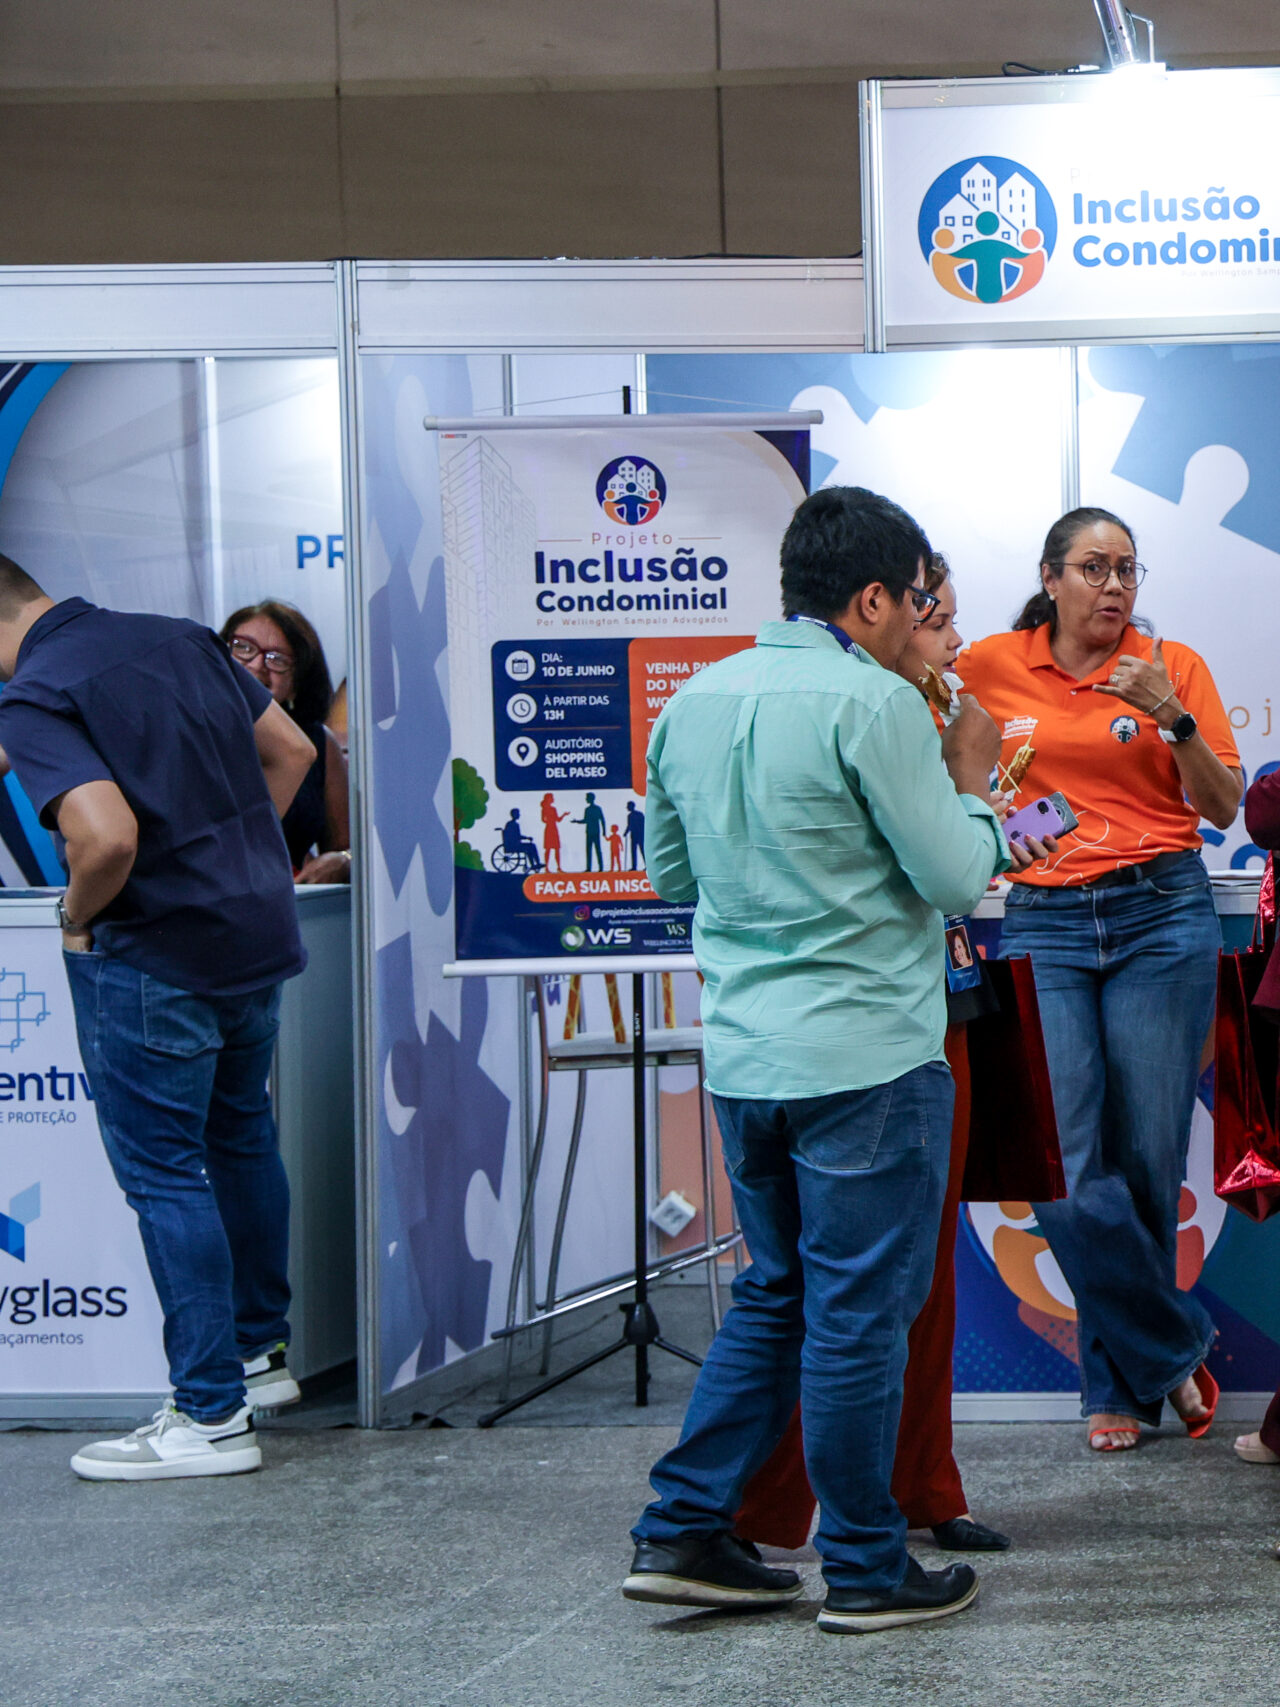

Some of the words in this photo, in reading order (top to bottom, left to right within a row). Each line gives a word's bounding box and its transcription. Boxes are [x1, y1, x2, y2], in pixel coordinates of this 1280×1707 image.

[1073, 186, 1261, 225] Inclusão
[591, 532, 673, 548] Projeto
[535, 547, 729, 584] Inclusão
[536, 587, 728, 613] Condominial
[536, 618, 555, 626] Por
[562, 617, 620, 628] Wellington
[624, 616, 668, 627] Sampaio
[673, 615, 729, 625] Advogados
[541, 652, 563, 664] DIA:
[542, 666, 556, 677] 10
[557, 665, 574, 677] DE
[575, 664, 615, 676] JUNHO
[645, 662, 690, 675] VENHA
[646, 679, 668, 692] DO
[553, 696, 589, 706] PARTIR
[590, 695, 610, 706] DAS
[543, 710, 565, 721] 13H
[544, 737, 603, 750] AUDITÓRIO
[545, 752, 605, 764] SHOPPING
[545, 767, 569, 779] DEL
[569, 766, 607, 778] PASEO
[535, 880, 577, 898] FAÇA
[580, 880, 611, 894] SUA
[614, 879, 654, 893] INSC
[587, 928, 632, 944] WS
[666, 924, 686, 935] WS
[8, 1109, 77, 1126] PROTEÇÃO
